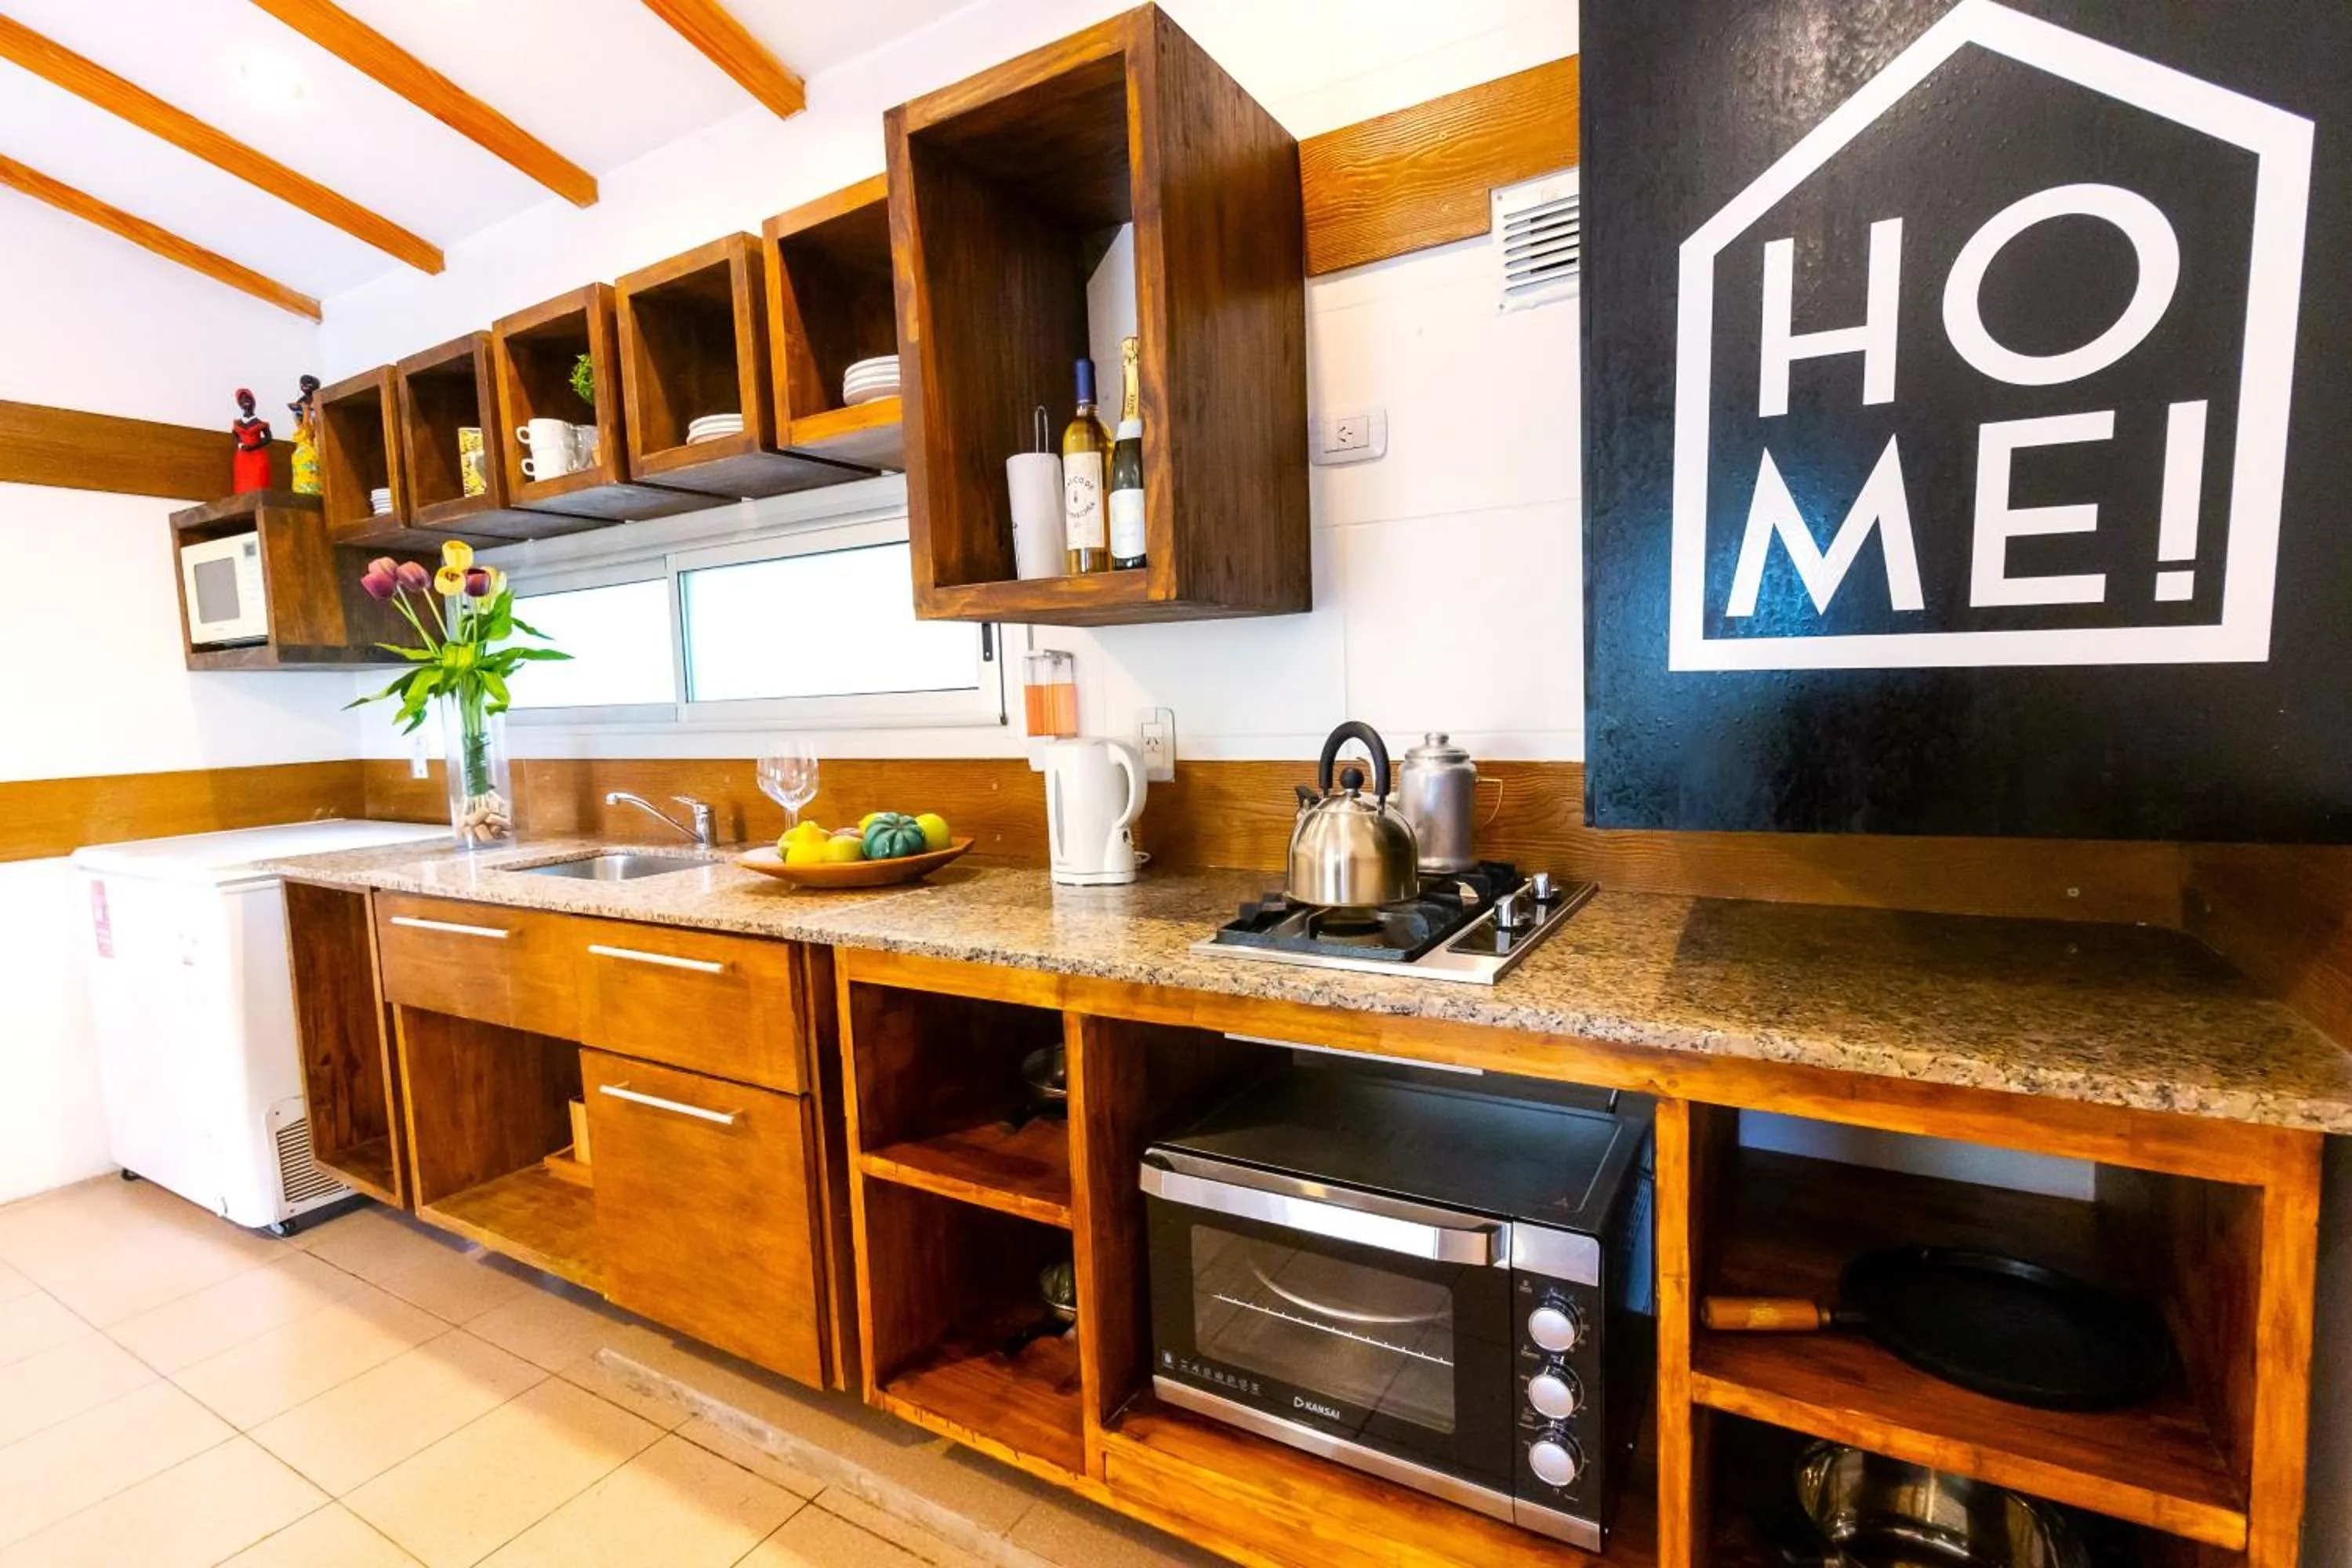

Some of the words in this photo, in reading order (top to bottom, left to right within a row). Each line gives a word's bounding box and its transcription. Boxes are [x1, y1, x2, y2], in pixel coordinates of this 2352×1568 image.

[1759, 183, 2180, 417] HO
[1726, 399, 2208, 616] ME!
[1305, 1401, 1340, 1420] KANSAI
